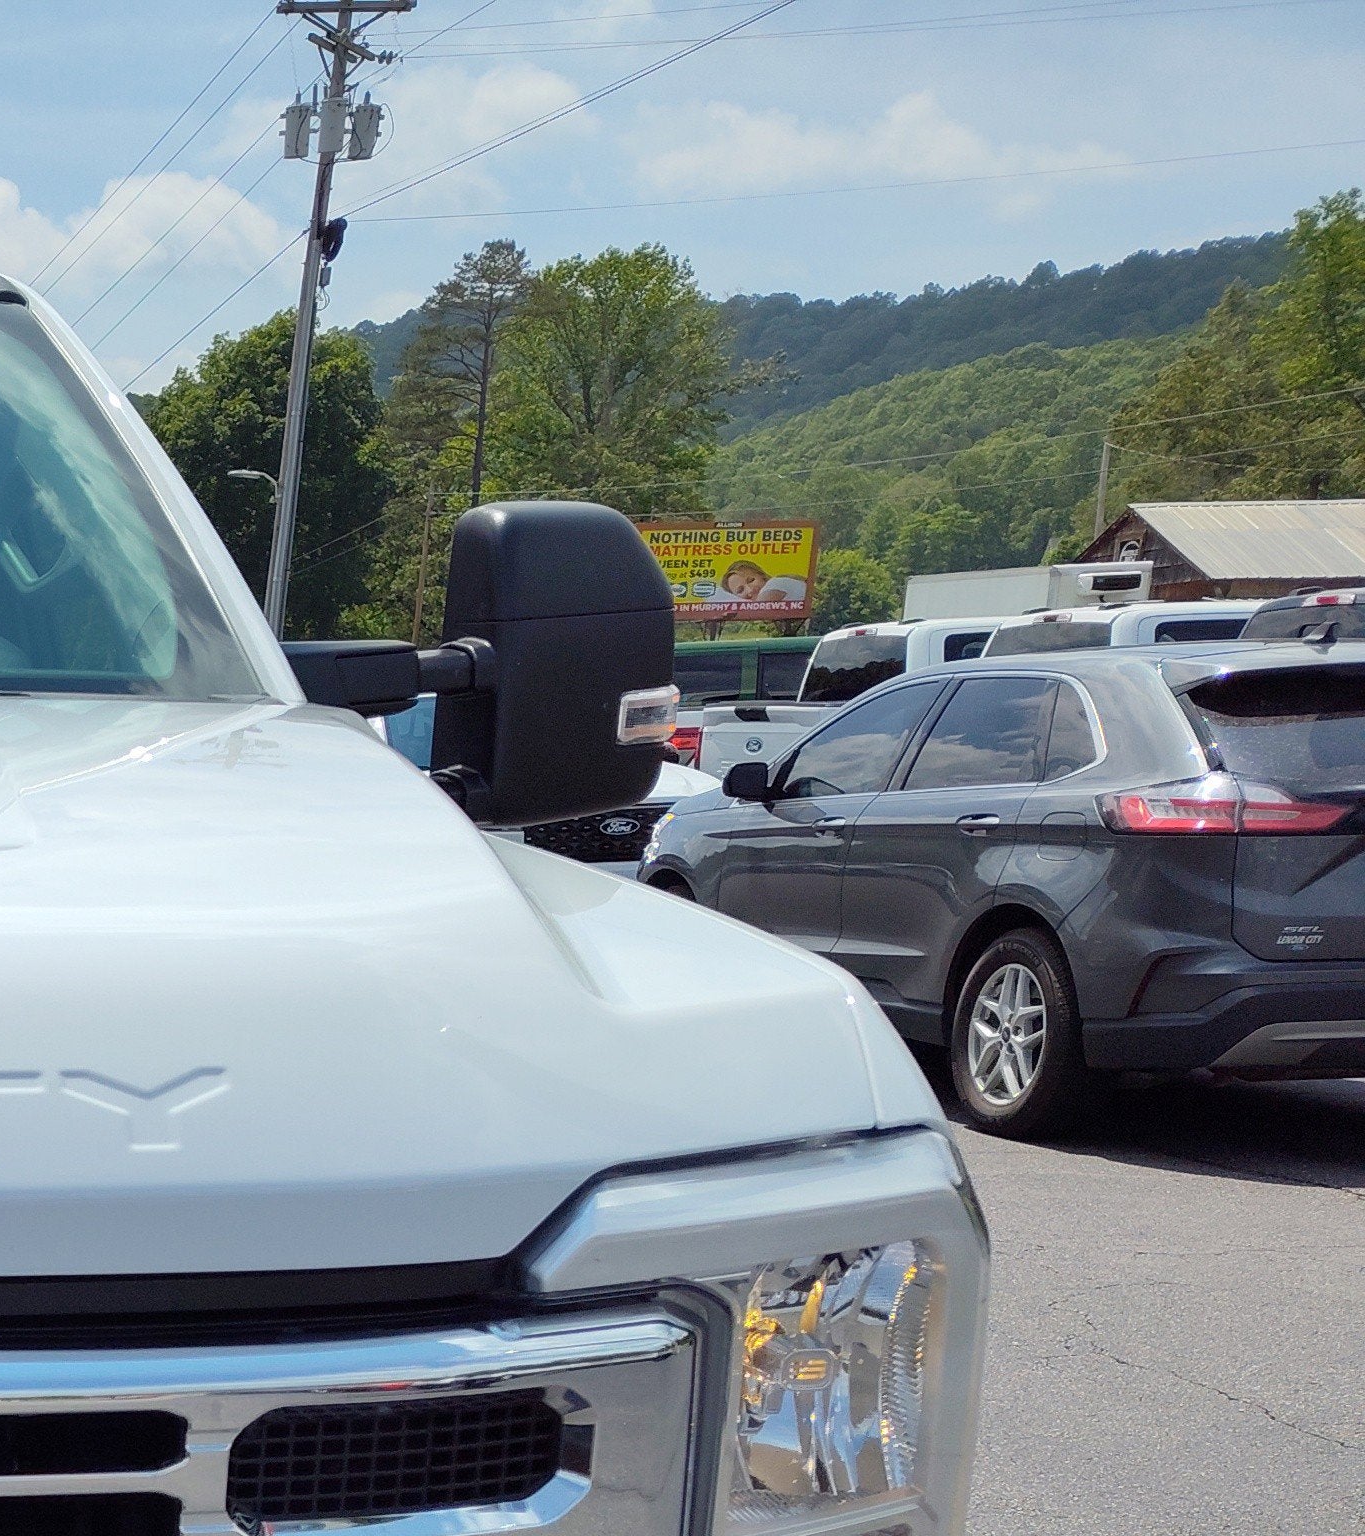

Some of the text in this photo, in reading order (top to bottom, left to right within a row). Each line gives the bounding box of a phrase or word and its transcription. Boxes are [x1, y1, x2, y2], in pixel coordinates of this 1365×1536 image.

[650, 529, 803, 544] NOTHING BUT BEDS
[650, 542, 801, 556] MATTRESS OUTLET
[659, 559, 713, 569] UEEN SET
[689, 569, 716, 578] $499
[680, 603, 689, 611] IN
[691, 602, 729, 612] MURPHY
[739, 601, 788, 611] ANDREWS,
[791, 601, 804, 609] NC
